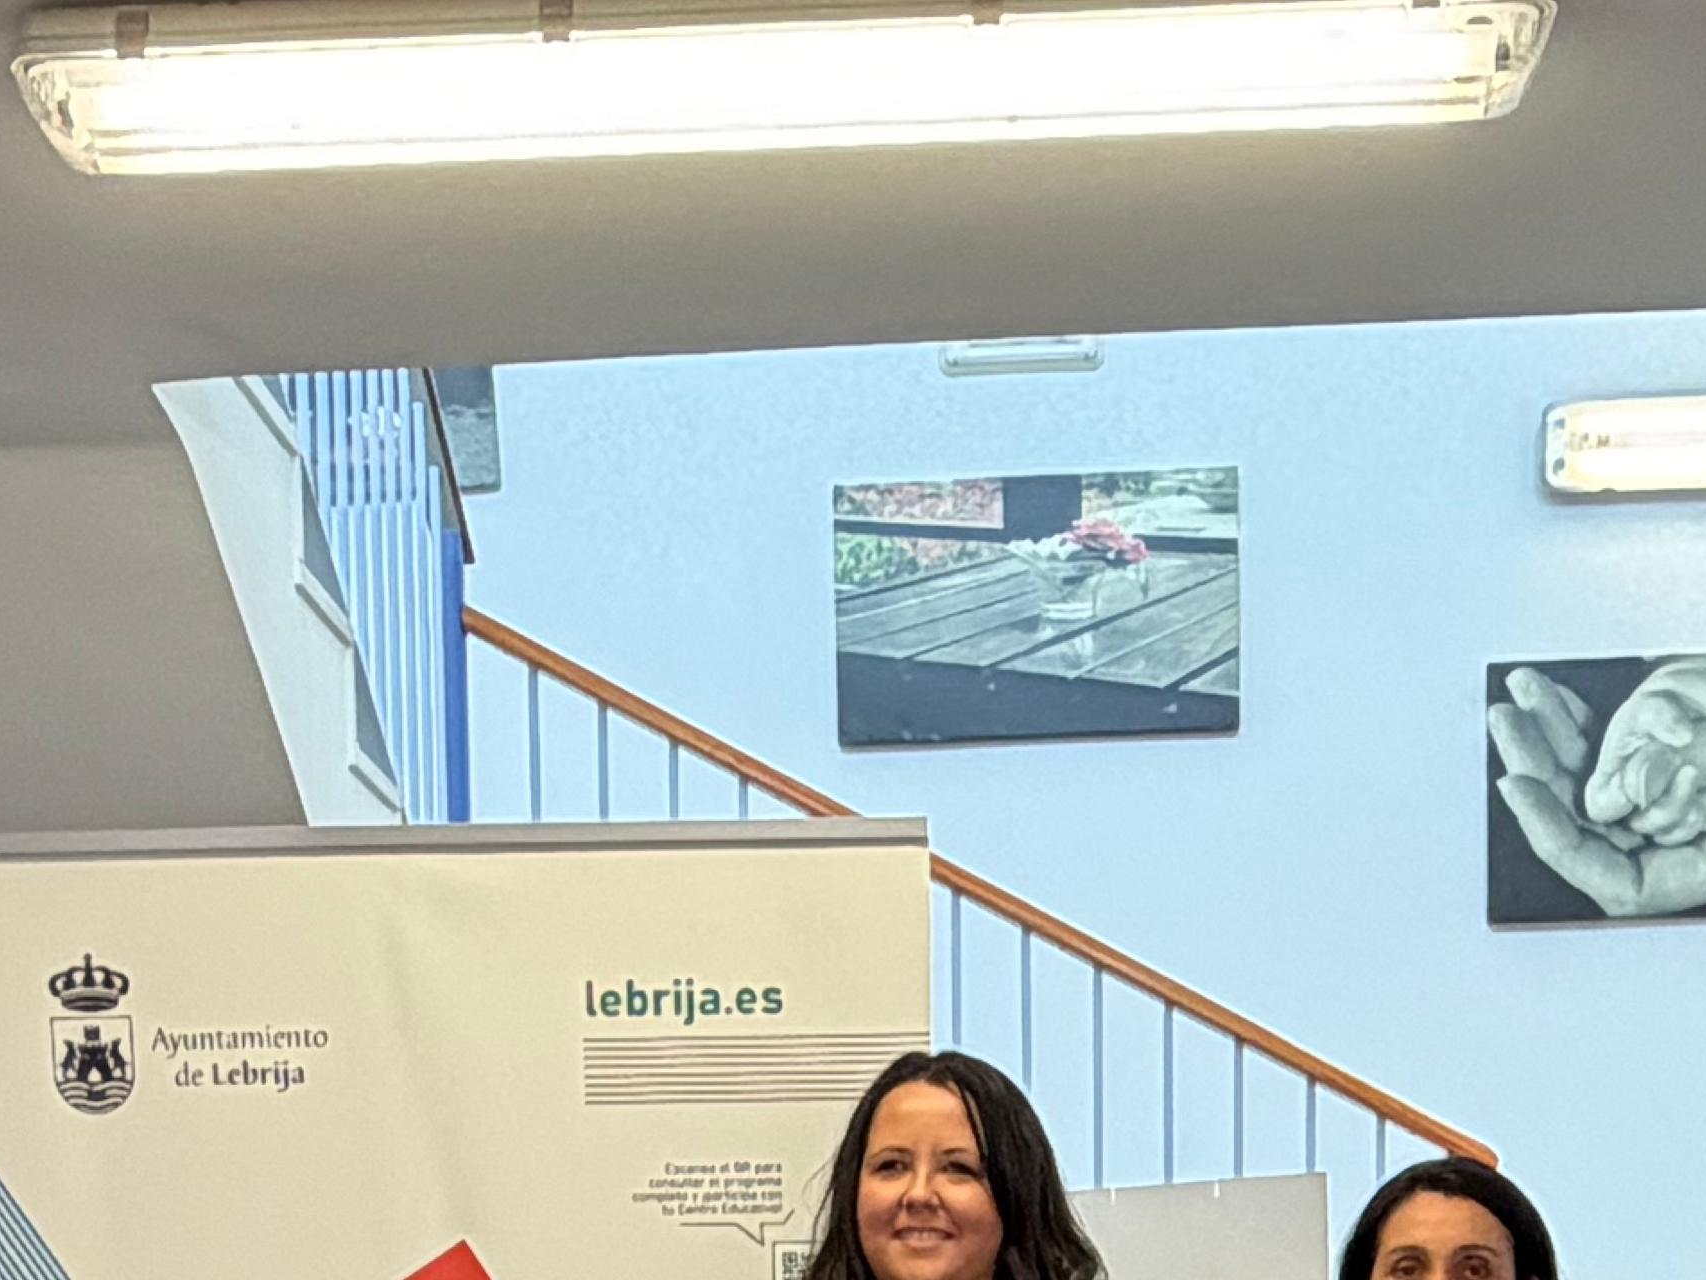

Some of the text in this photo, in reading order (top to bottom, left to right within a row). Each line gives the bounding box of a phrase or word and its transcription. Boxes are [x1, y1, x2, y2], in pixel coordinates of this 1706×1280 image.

[586, 978, 783, 1026] lebrija.es
[151, 1024, 329, 1059] Ayuntamiento
[175, 1059, 305, 1092] de Lebrija
